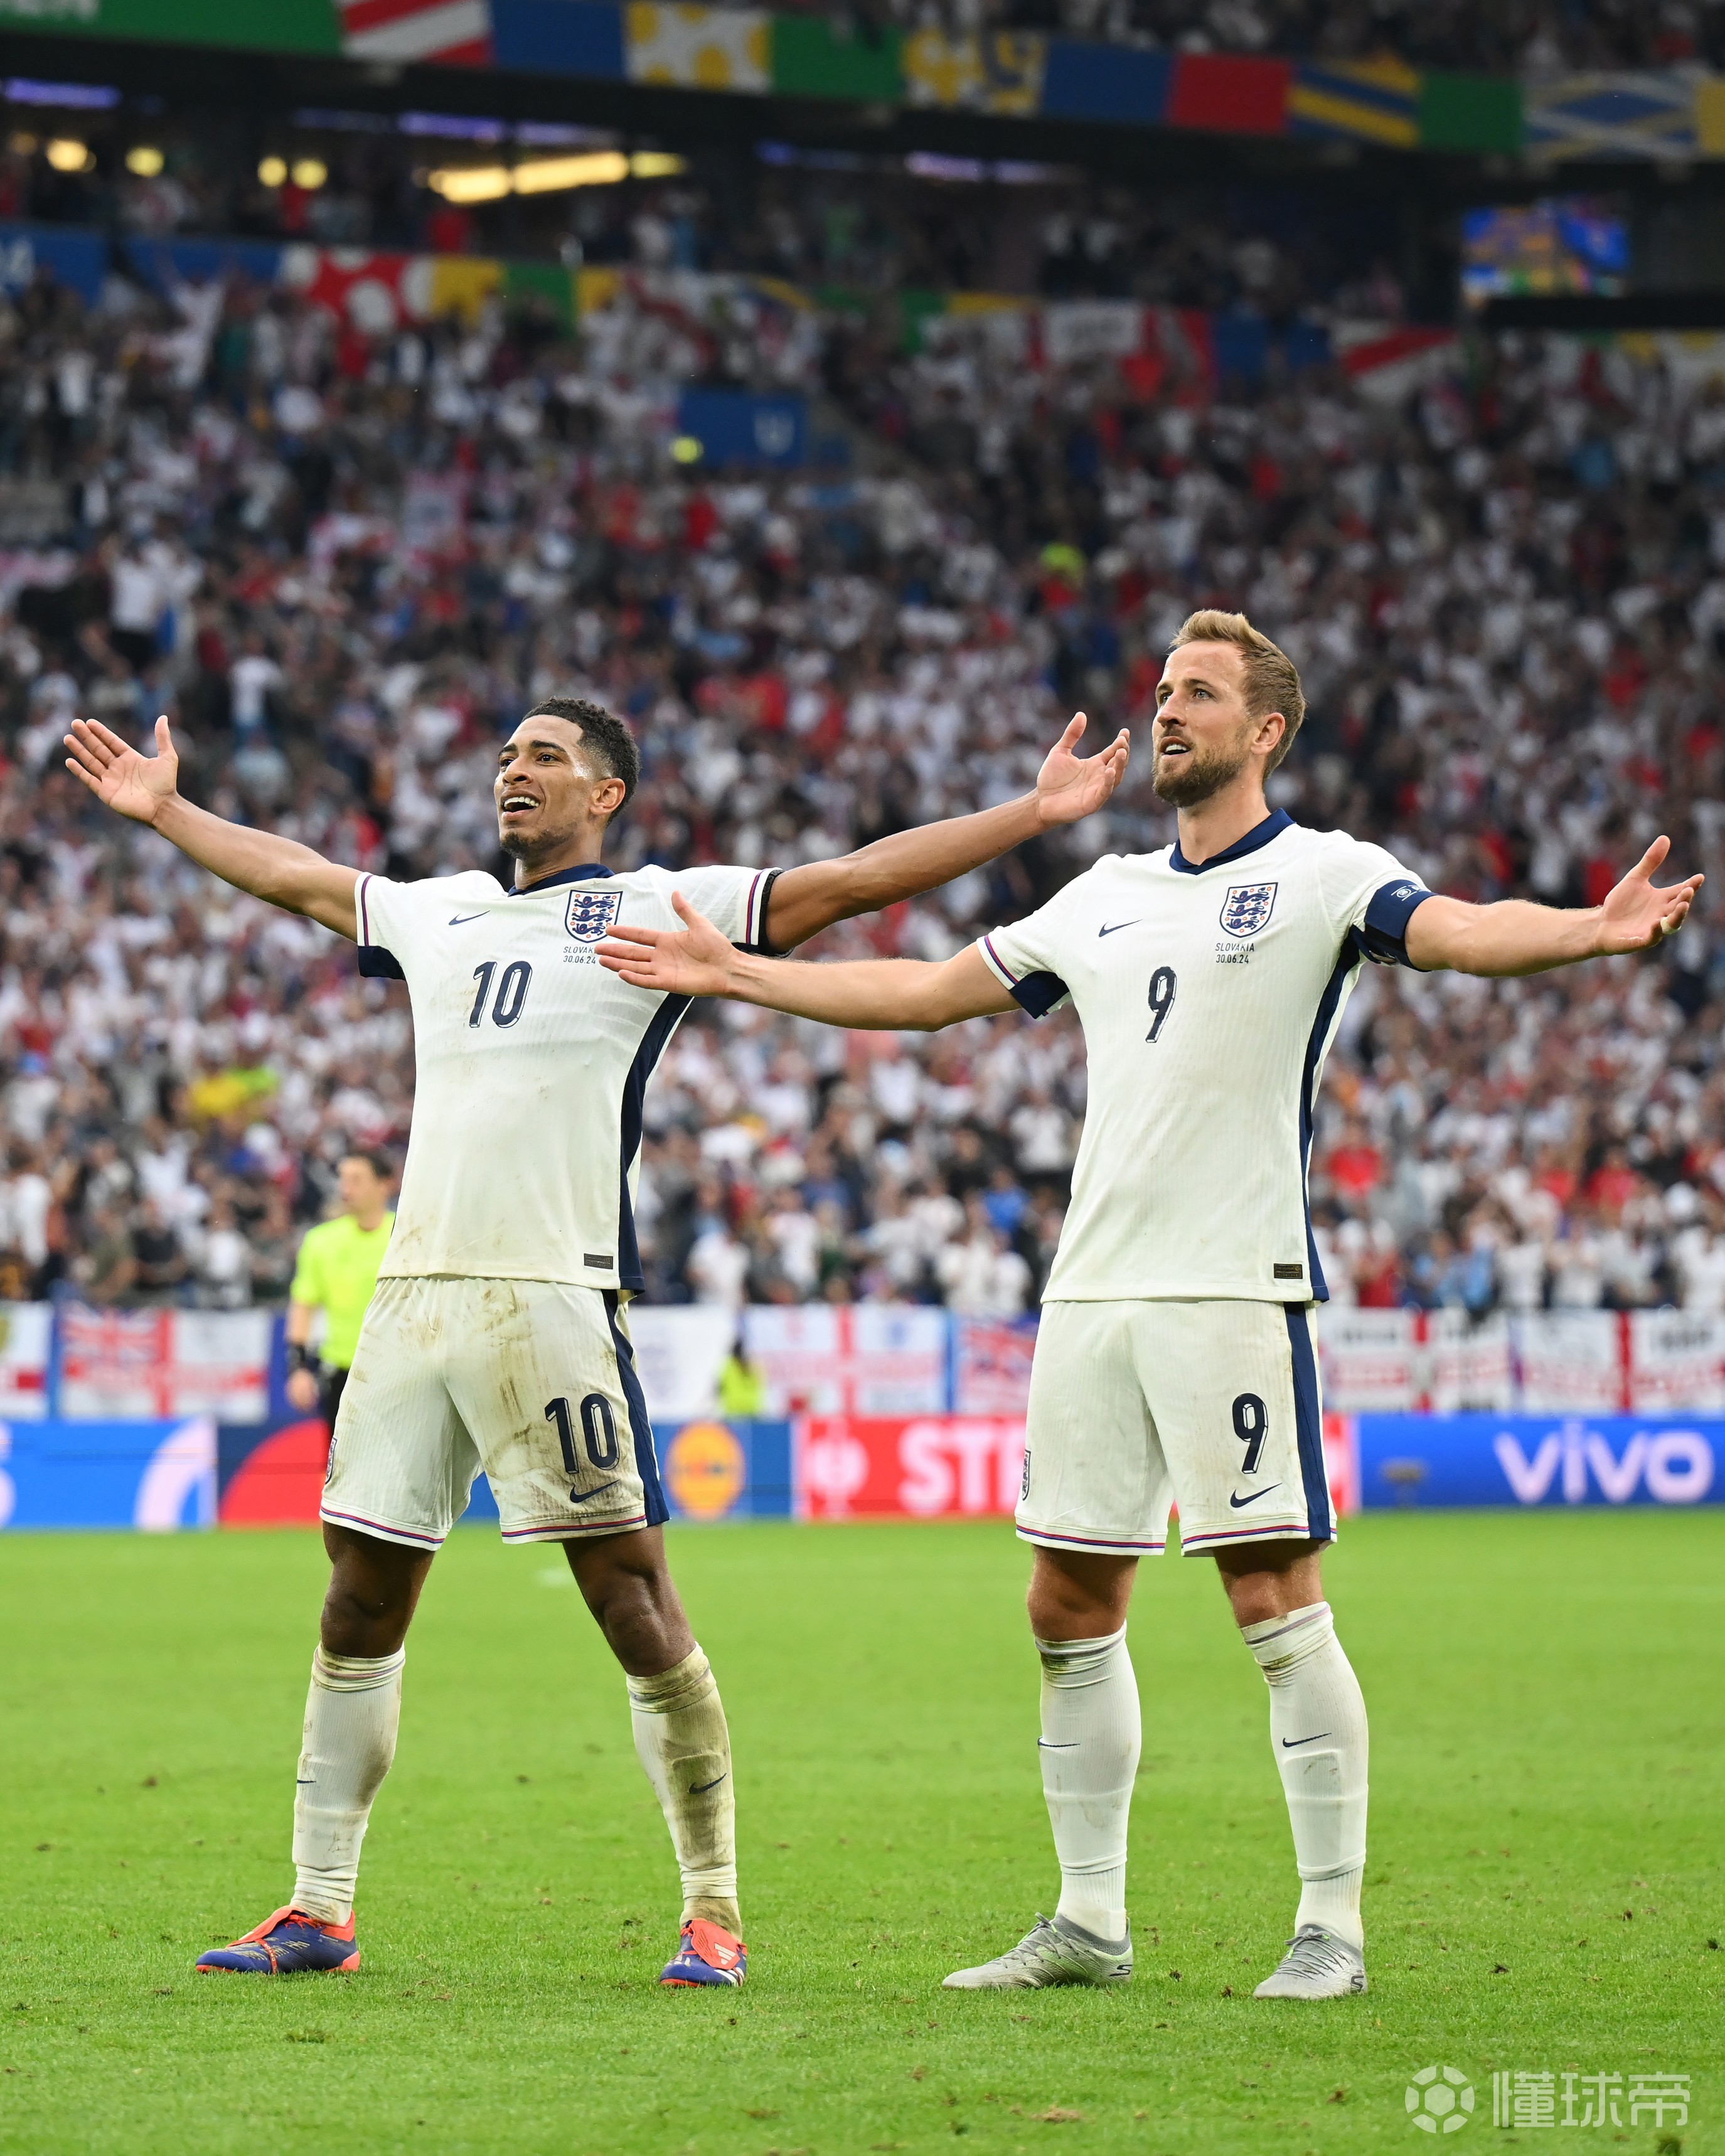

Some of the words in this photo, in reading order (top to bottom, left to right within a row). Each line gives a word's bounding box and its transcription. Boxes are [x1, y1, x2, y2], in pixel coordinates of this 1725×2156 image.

[563, 946, 594, 954] SLOVAK
[563, 955, 596, 964] 30.06.24
[1215, 943, 1255, 952] SLOVAKIA
[1215, 954, 1249, 964] 30.06.24
[469, 961, 533, 1028] 10
[1145, 966, 1178, 1043] 9
[544, 1393, 621, 1475] 10
[1232, 1392, 1269, 1475] 9
[1493, 1421, 1715, 1504] vivo
